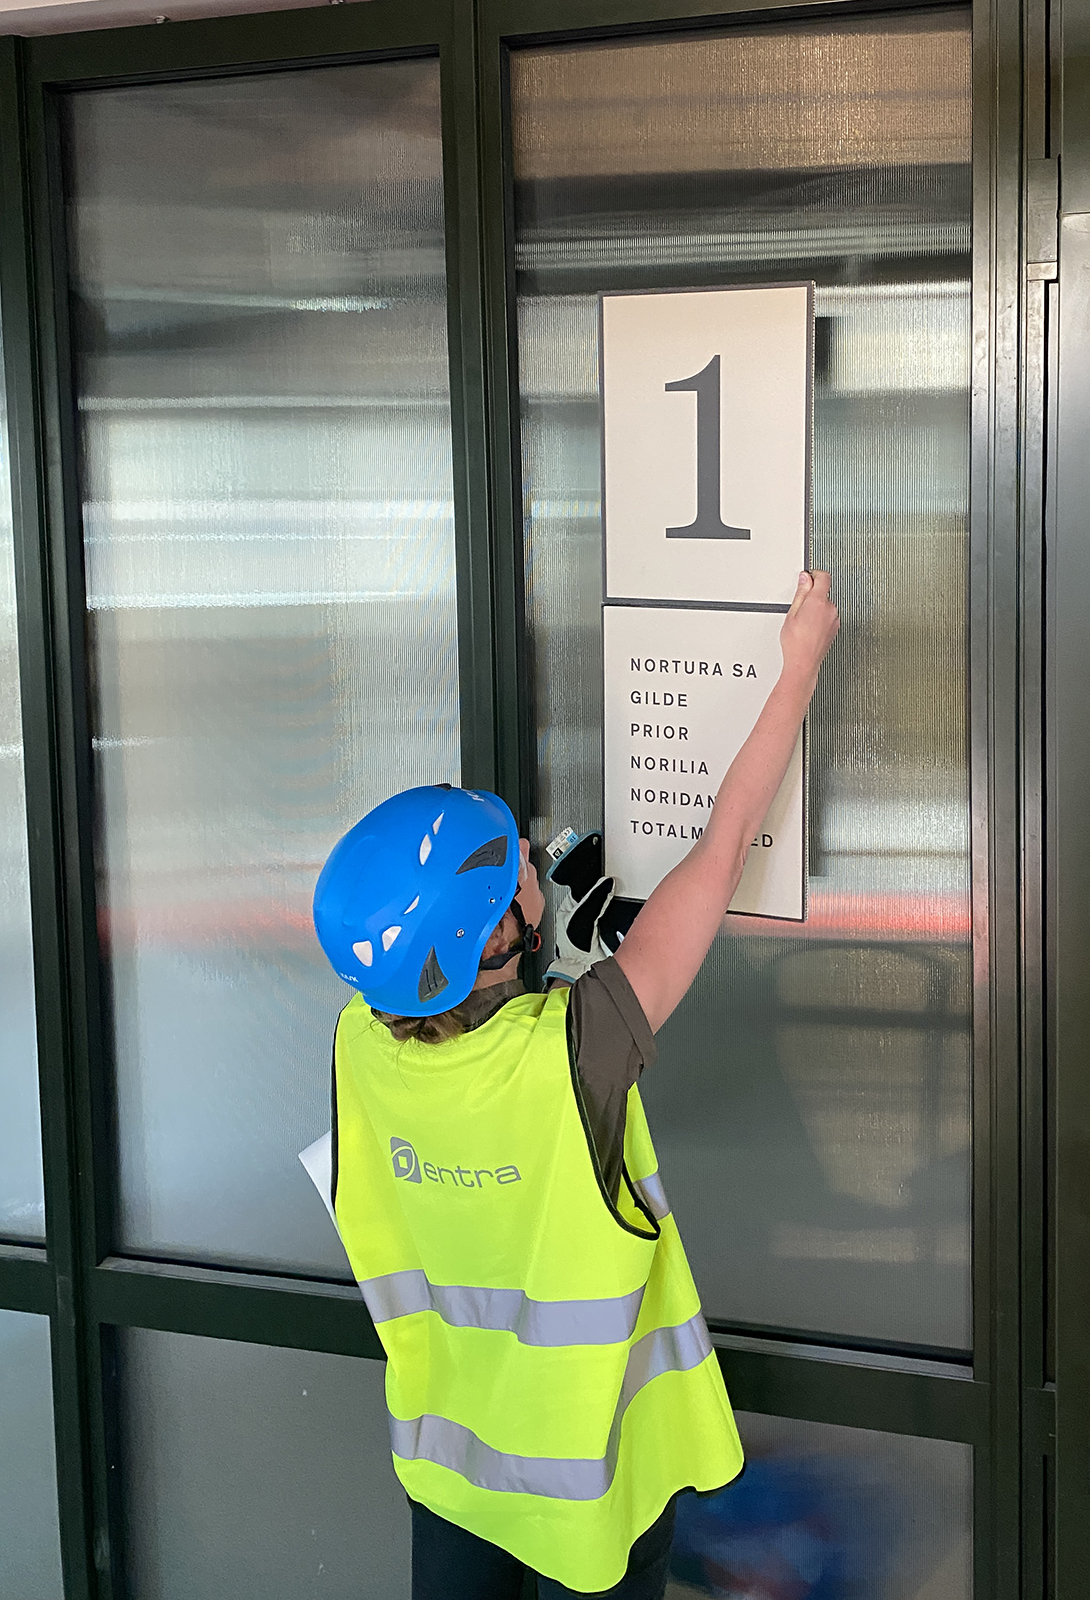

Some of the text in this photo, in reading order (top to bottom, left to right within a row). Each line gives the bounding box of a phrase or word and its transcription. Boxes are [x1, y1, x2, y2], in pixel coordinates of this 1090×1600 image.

[665, 355, 750, 540] 1
[631, 658, 756, 678] NORTURA SA
[631, 691, 687, 707] GILDE
[631, 724, 687, 740] PRIOR
[631, 756, 708, 775] NORILIA
[423, 1161, 522, 1188] entra
